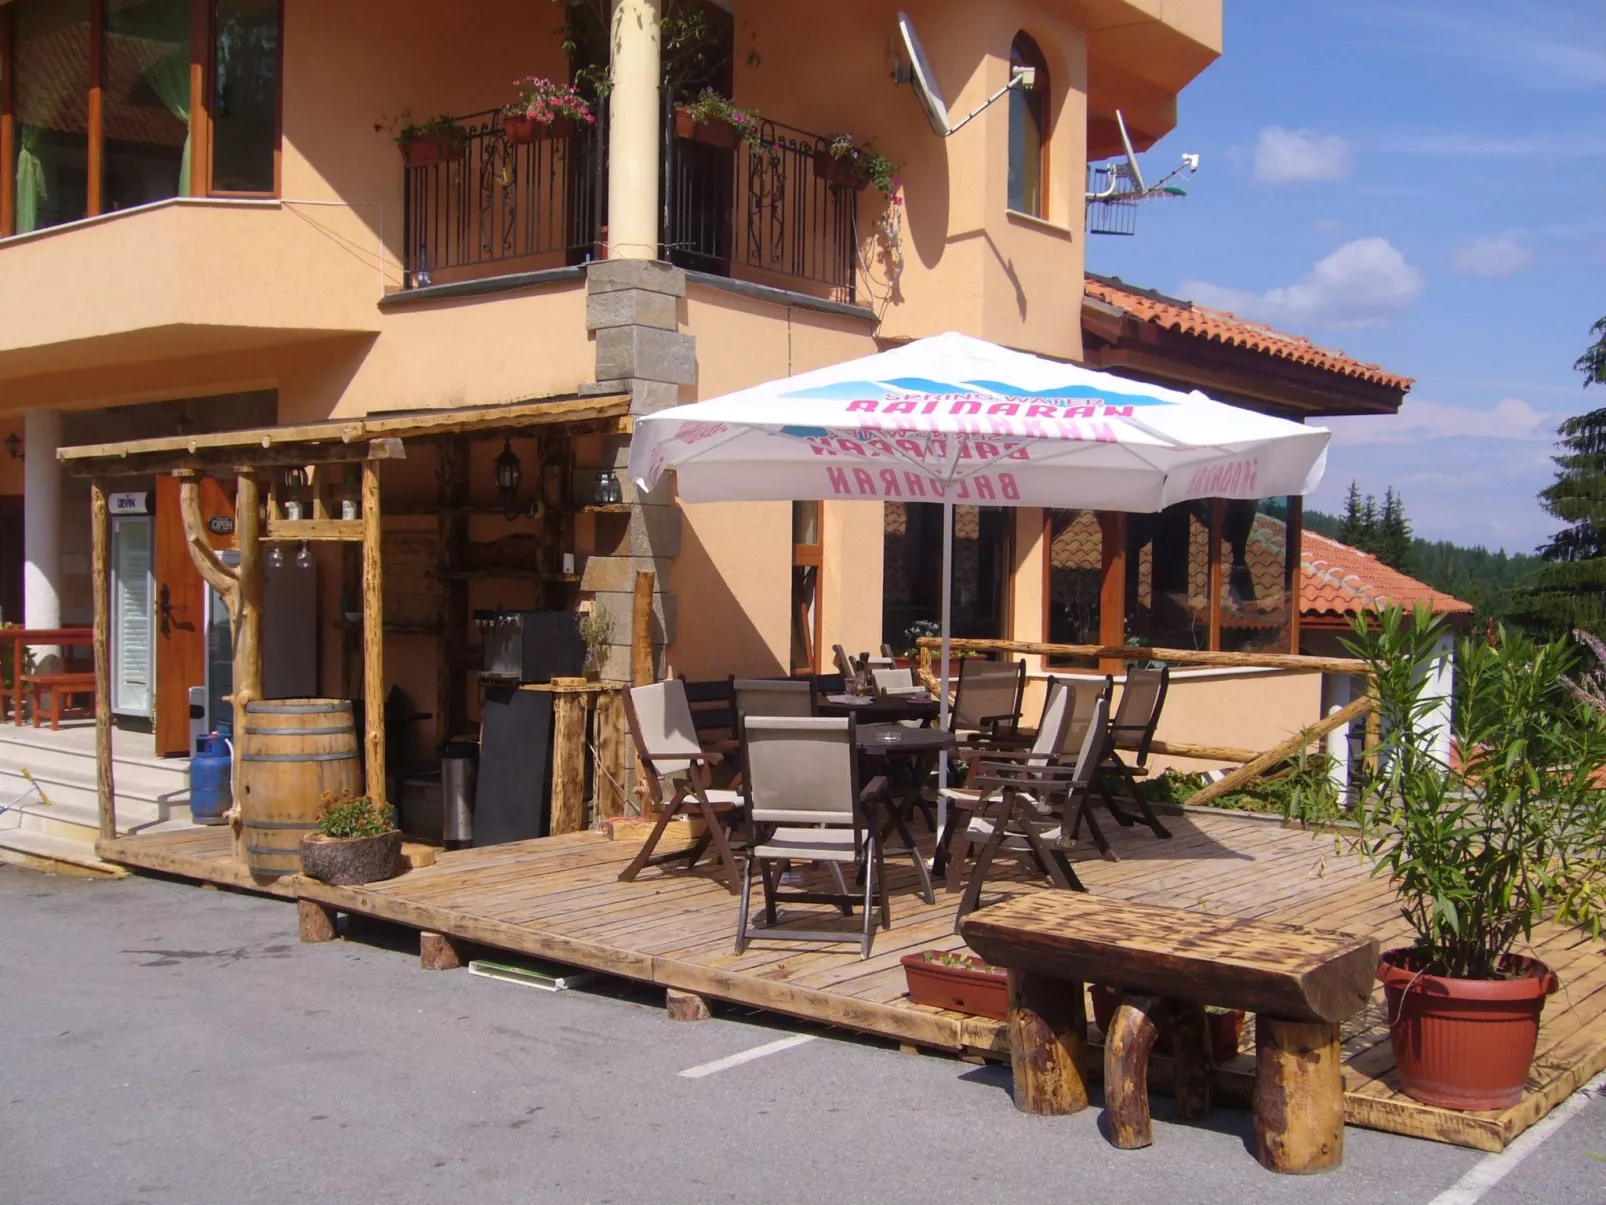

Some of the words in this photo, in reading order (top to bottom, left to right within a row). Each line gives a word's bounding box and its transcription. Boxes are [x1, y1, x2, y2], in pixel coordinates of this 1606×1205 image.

[884, 393, 994, 401] SPRING
[1004, 396, 1105, 406] WATER
[211, 519, 233, 530] OPEN
